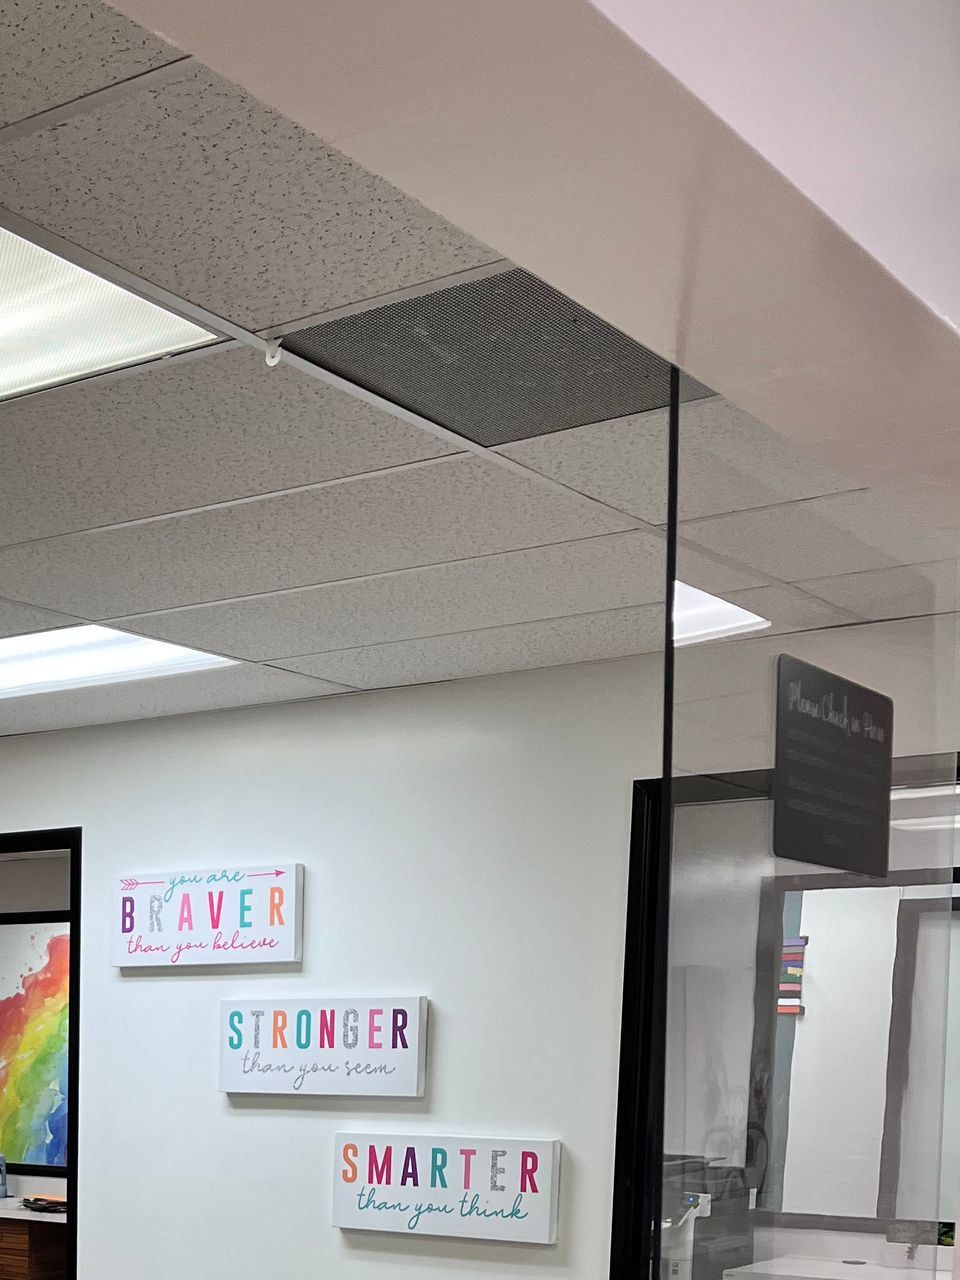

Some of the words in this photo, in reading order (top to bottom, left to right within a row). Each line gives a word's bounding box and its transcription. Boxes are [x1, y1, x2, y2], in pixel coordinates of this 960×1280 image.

[164, 870, 202, 903] you
[206, 869, 246, 884] are
[121, 886, 285, 934] BRAVER
[126, 934, 171, 955] than
[171, 937, 208, 963] you
[212, 930, 279, 951] believe
[228, 1007, 410, 1051] STRONGER
[240, 1049, 294, 1075] than
[292, 1062, 339, 1090] you
[344, 1061, 396, 1076] seem
[342, 1142, 539, 1194] SMARTER
[356, 1186, 410, 1212] than
[407, 1205, 454, 1230] you
[458, 1190, 530, 1220] think
